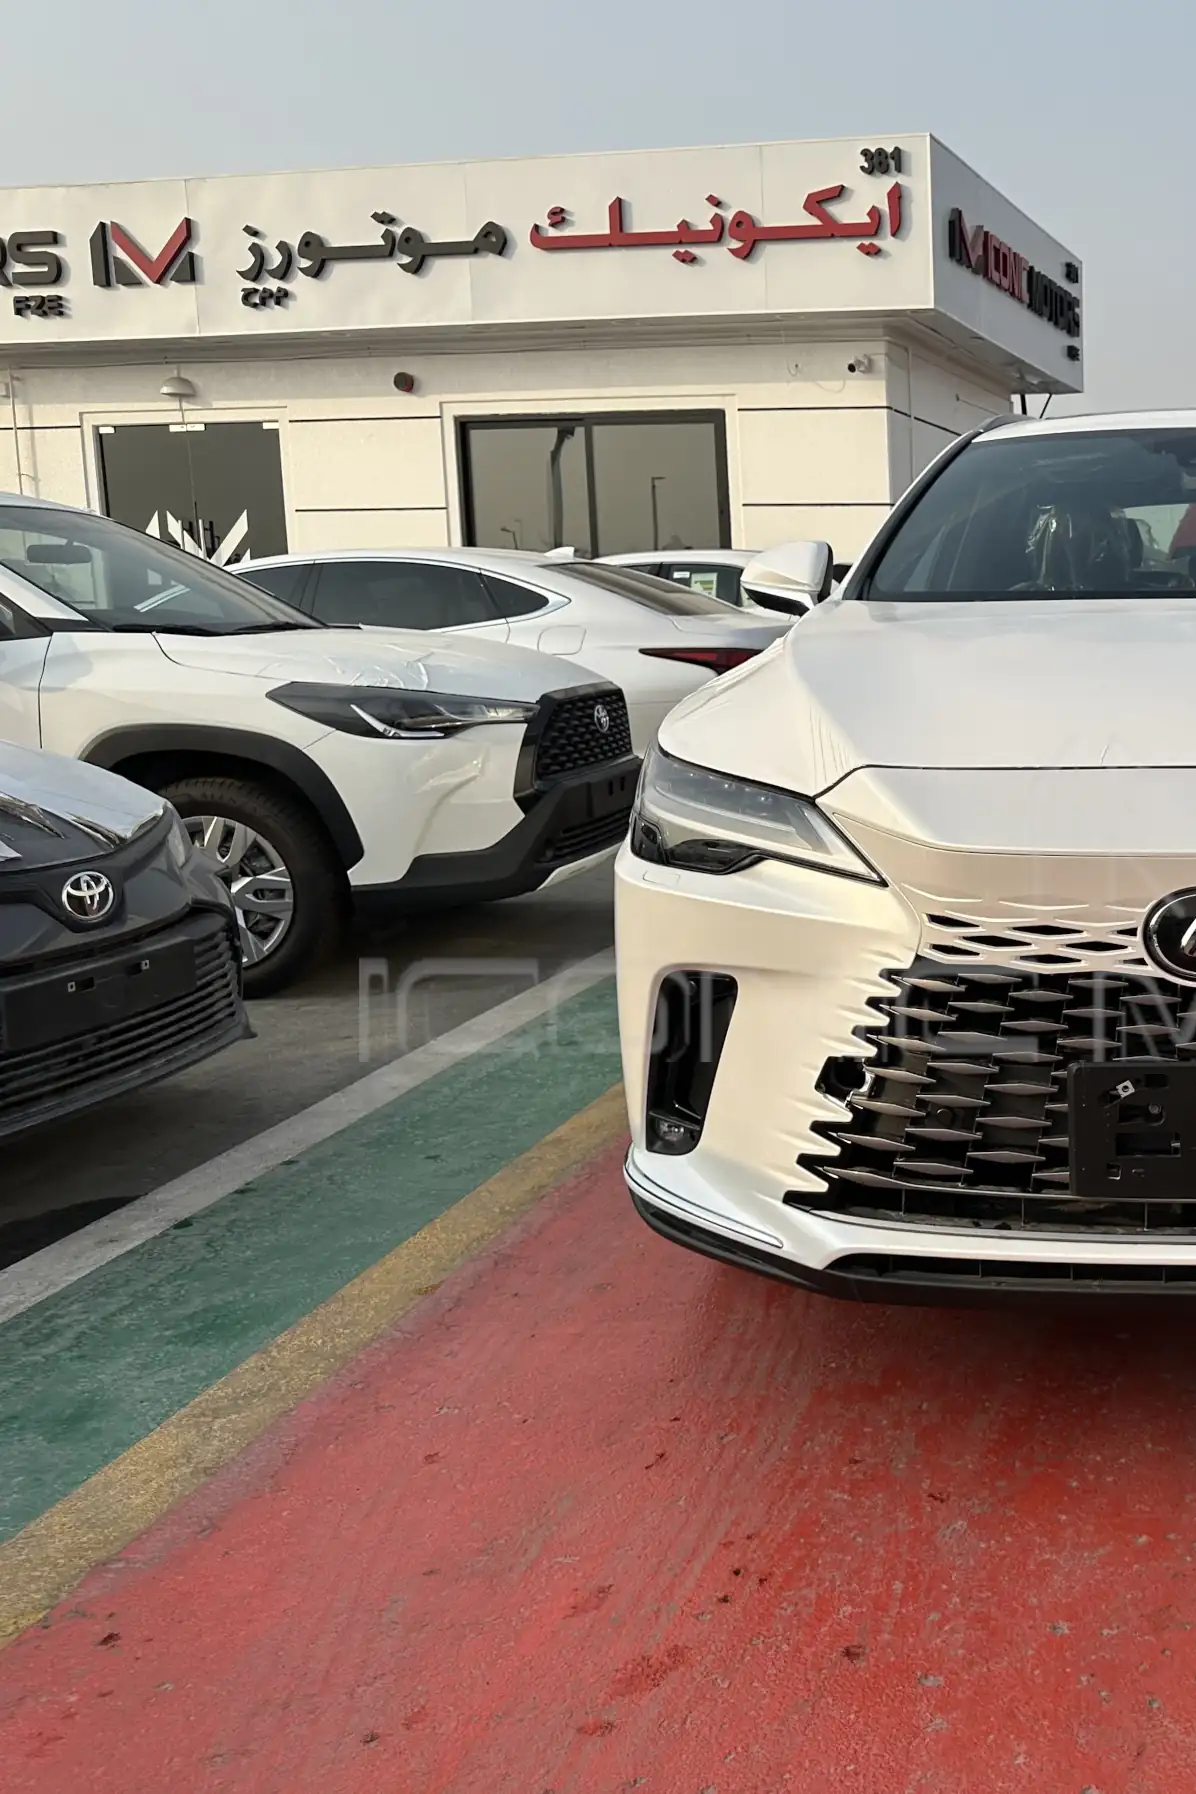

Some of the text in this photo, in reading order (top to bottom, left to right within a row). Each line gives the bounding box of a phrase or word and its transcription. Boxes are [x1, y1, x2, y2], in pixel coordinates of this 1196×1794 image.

[859, 146, 902, 175] 381
[0, 230, 63, 287] S
[236, 210, 508, 283] موتورز
